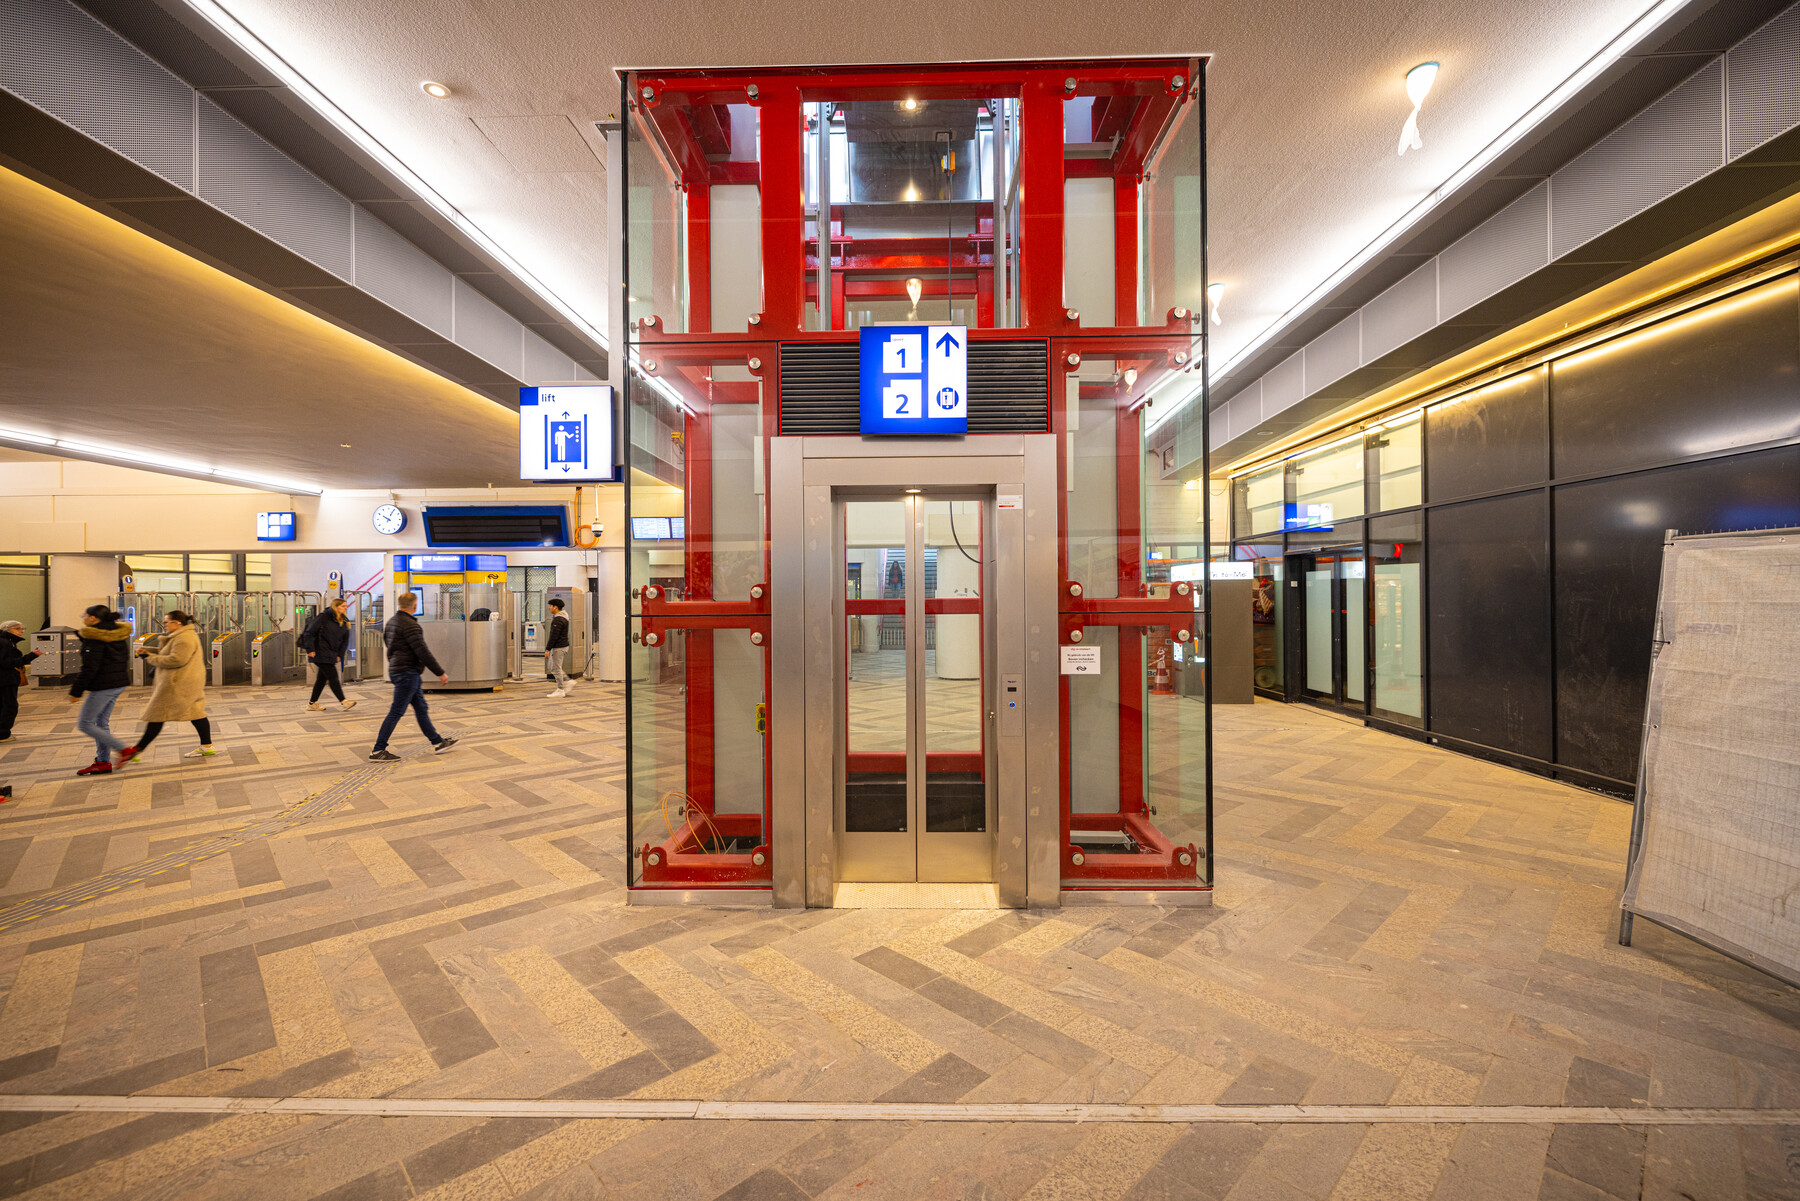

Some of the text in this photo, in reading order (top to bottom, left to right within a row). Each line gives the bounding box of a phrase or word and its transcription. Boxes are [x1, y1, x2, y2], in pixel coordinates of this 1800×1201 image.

[896, 348, 906, 368] 1
[541, 394, 555, 402] lift
[895, 393, 909, 414] 2
